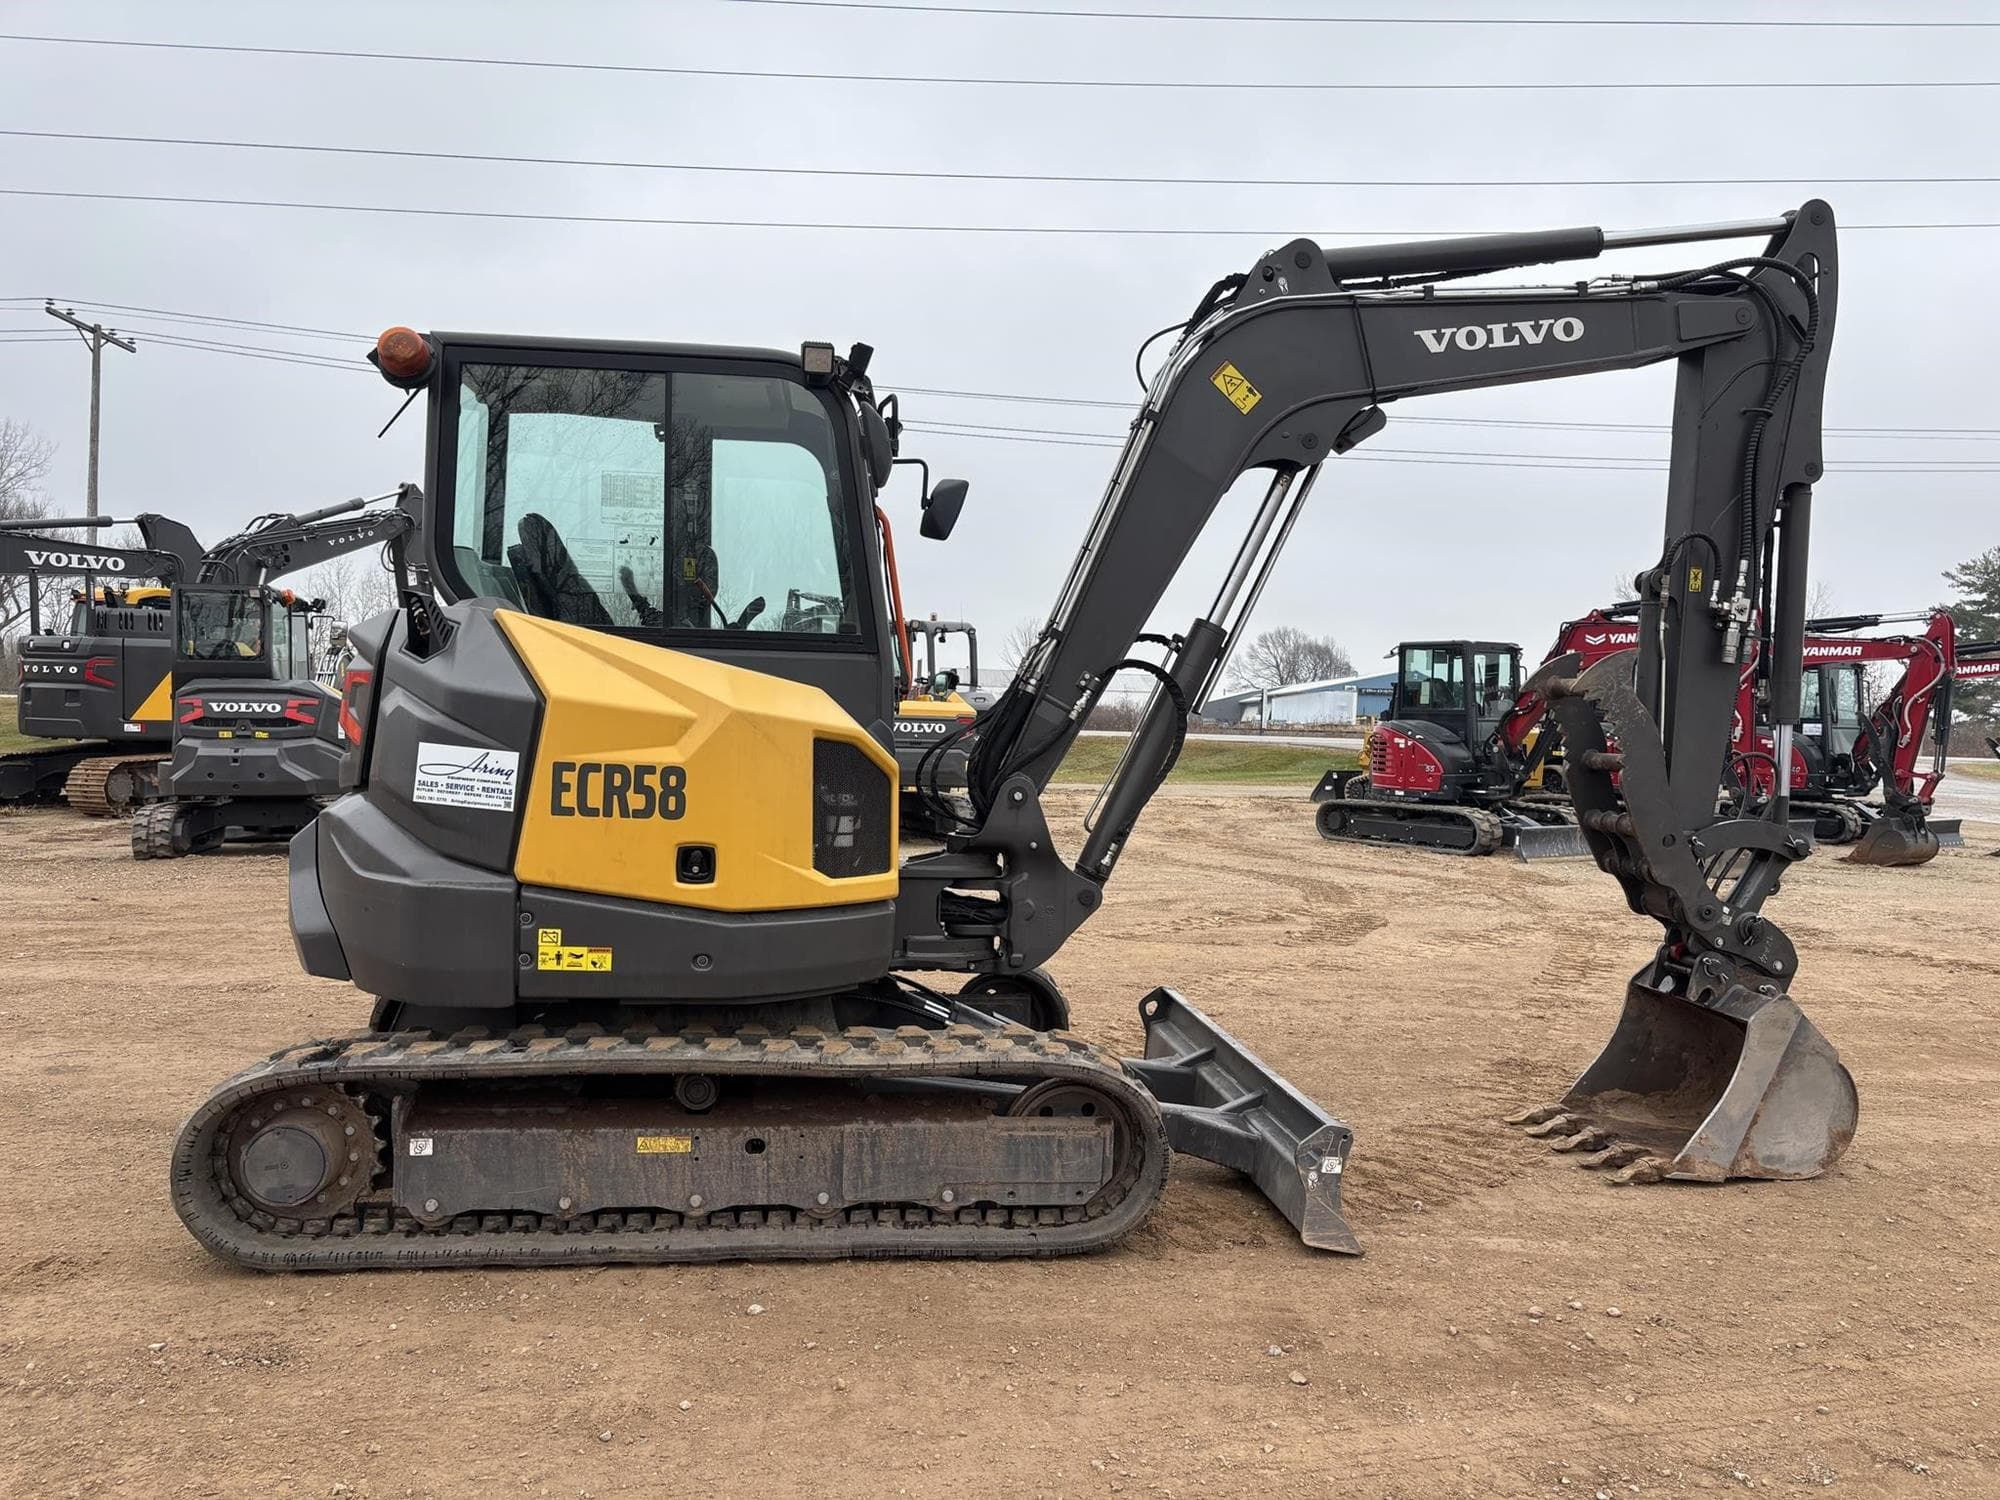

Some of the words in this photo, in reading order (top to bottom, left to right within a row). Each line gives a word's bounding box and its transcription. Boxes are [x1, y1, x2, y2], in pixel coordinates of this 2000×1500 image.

[1414, 317, 1585, 353] VOLVO
[328, 530, 374, 546] VOLVO
[24, 550, 125, 571] VOLVO
[1608, 633, 1639, 644] YAN
[1803, 646, 1863, 656] YANMAR
[23, 665, 78, 674] VOLVO
[1955, 663, 2000, 675] ANMAR
[208, 702, 282, 713] VOLVO
[419, 752, 515, 780] Aring
[417, 779, 439, 788] SALES
[445, 783, 475, 792] SERVICE
[481, 786, 513, 796] RENTALS
[551, 761, 687, 820] ECR58
